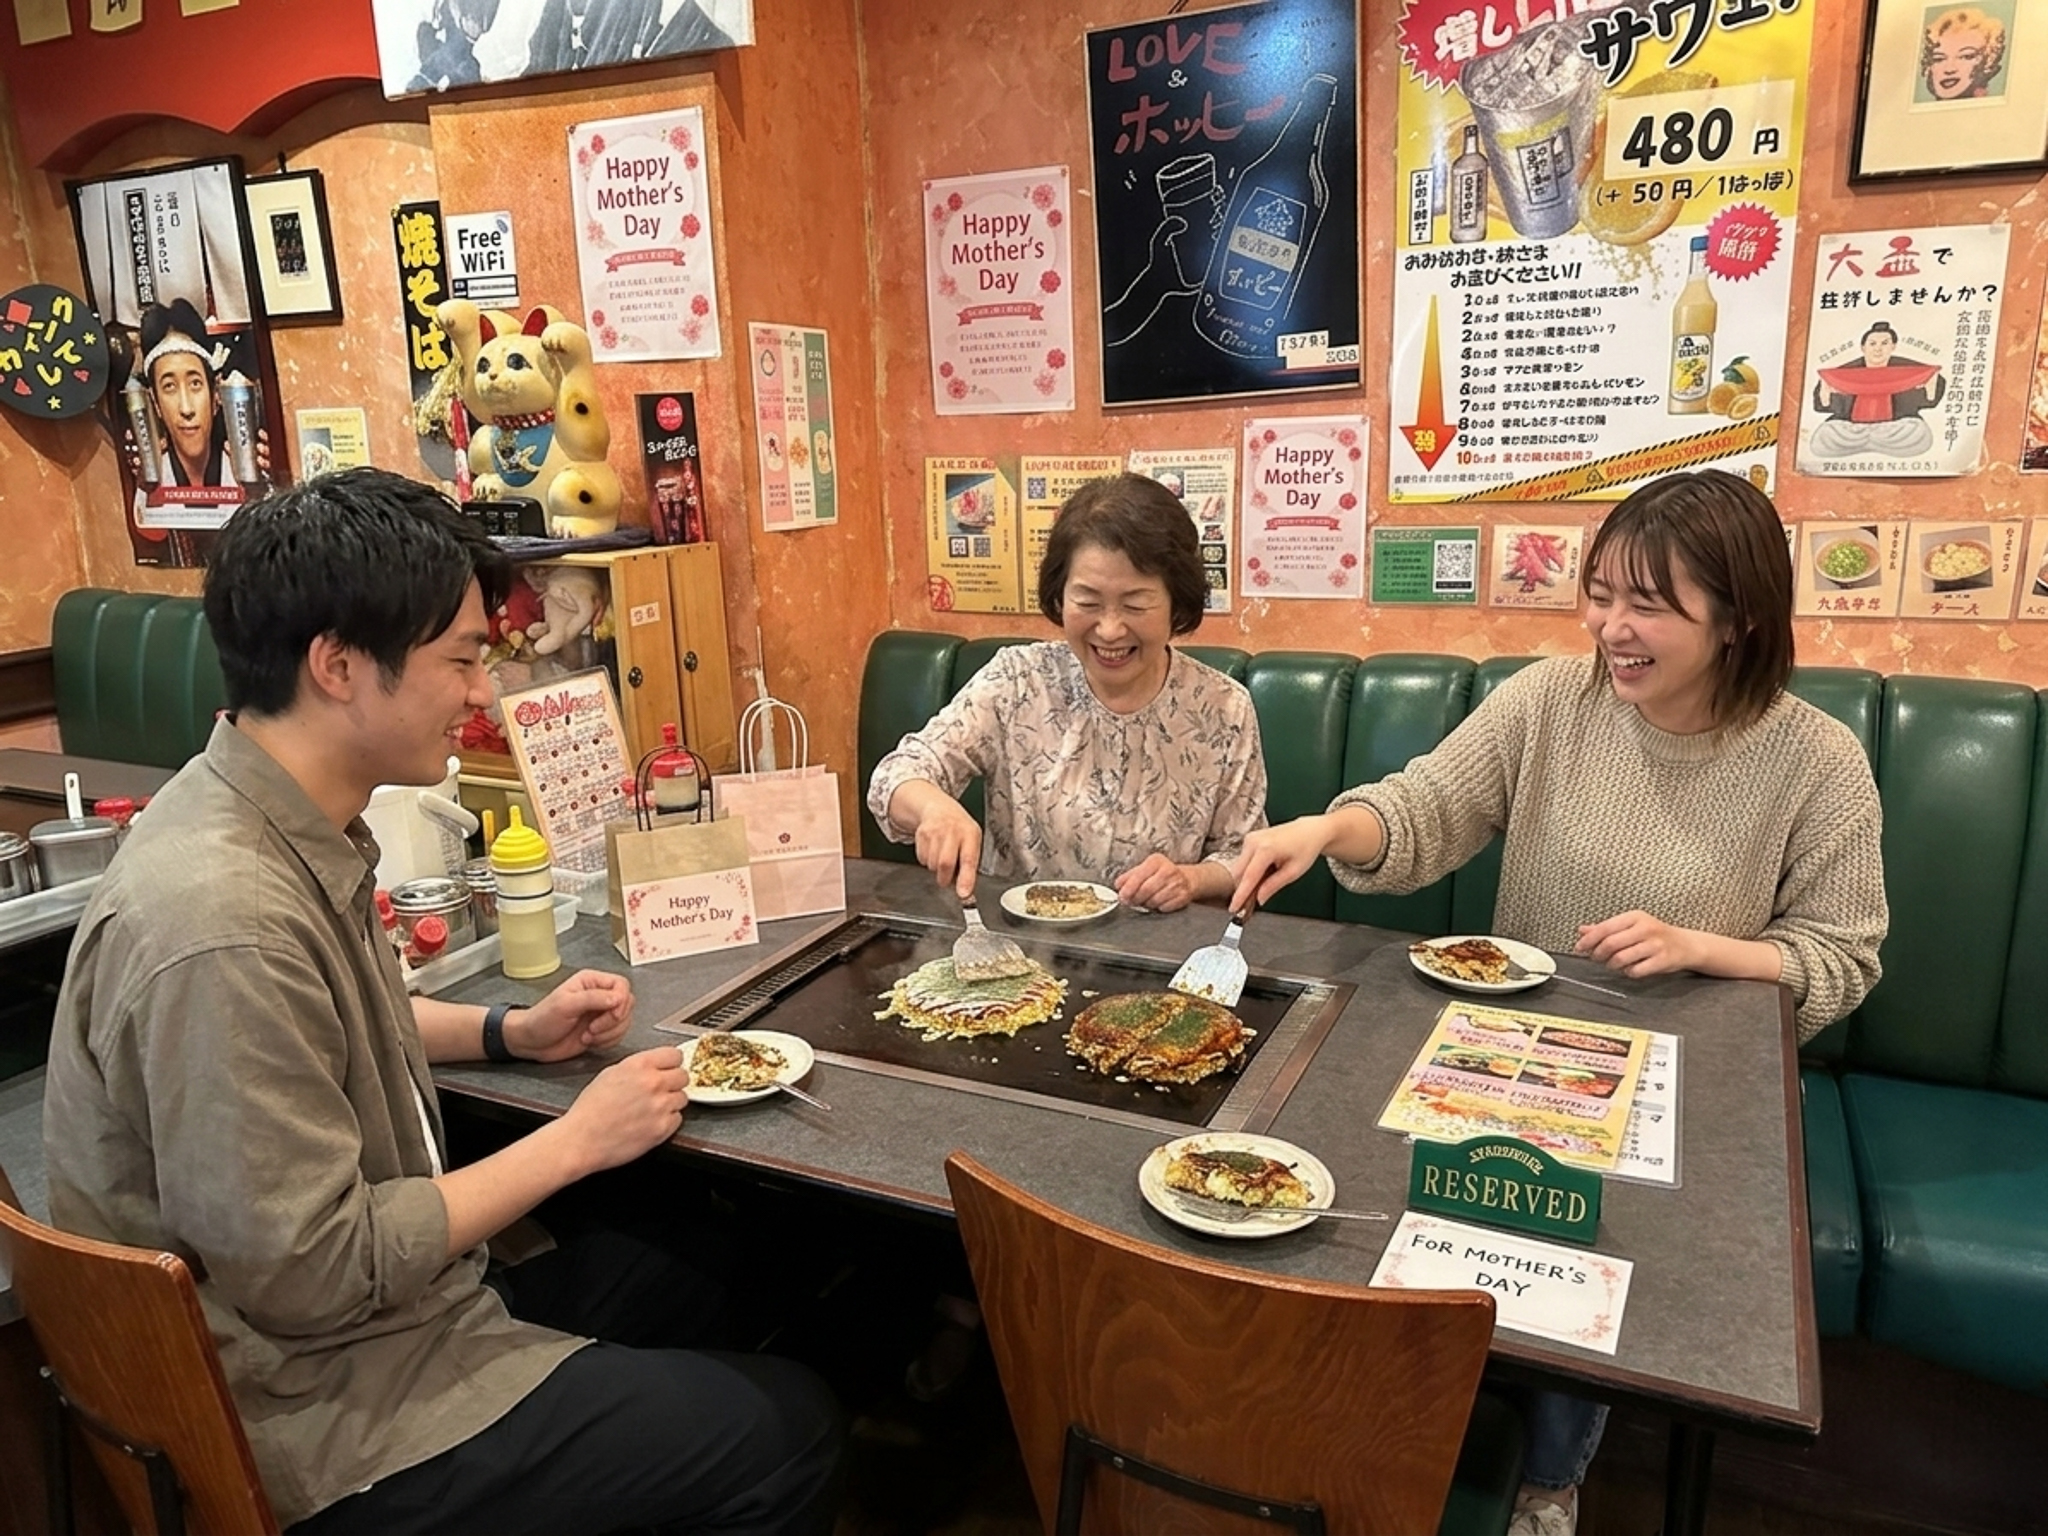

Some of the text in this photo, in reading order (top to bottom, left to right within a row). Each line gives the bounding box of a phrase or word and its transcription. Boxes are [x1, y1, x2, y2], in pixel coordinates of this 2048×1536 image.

[1108, 23, 1247, 83] LOVE
[1167, 69, 1188, 88] &
[1622, 107, 1780, 168] 480 円
[606, 156, 670, 183] Happy
[597, 182, 684, 210] Mother's
[1632, 181, 1663, 204] 50
[624, 215, 661, 240] Day
[962, 213, 1031, 239] Happy
[457, 229, 502, 250] Free
[951, 237, 1045, 265] Mother's
[979, 269, 1019, 294] Day
[1275, 446, 1334, 468] Happy
[1264, 467, 1345, 486] Mother's
[1286, 490, 1321, 510] Day
[669, 895, 710, 910] Happy
[709, 907, 734, 921] Day
[1422, 1165, 1587, 1223] RESERVED
[1475, 1273, 1532, 1298] DAY
